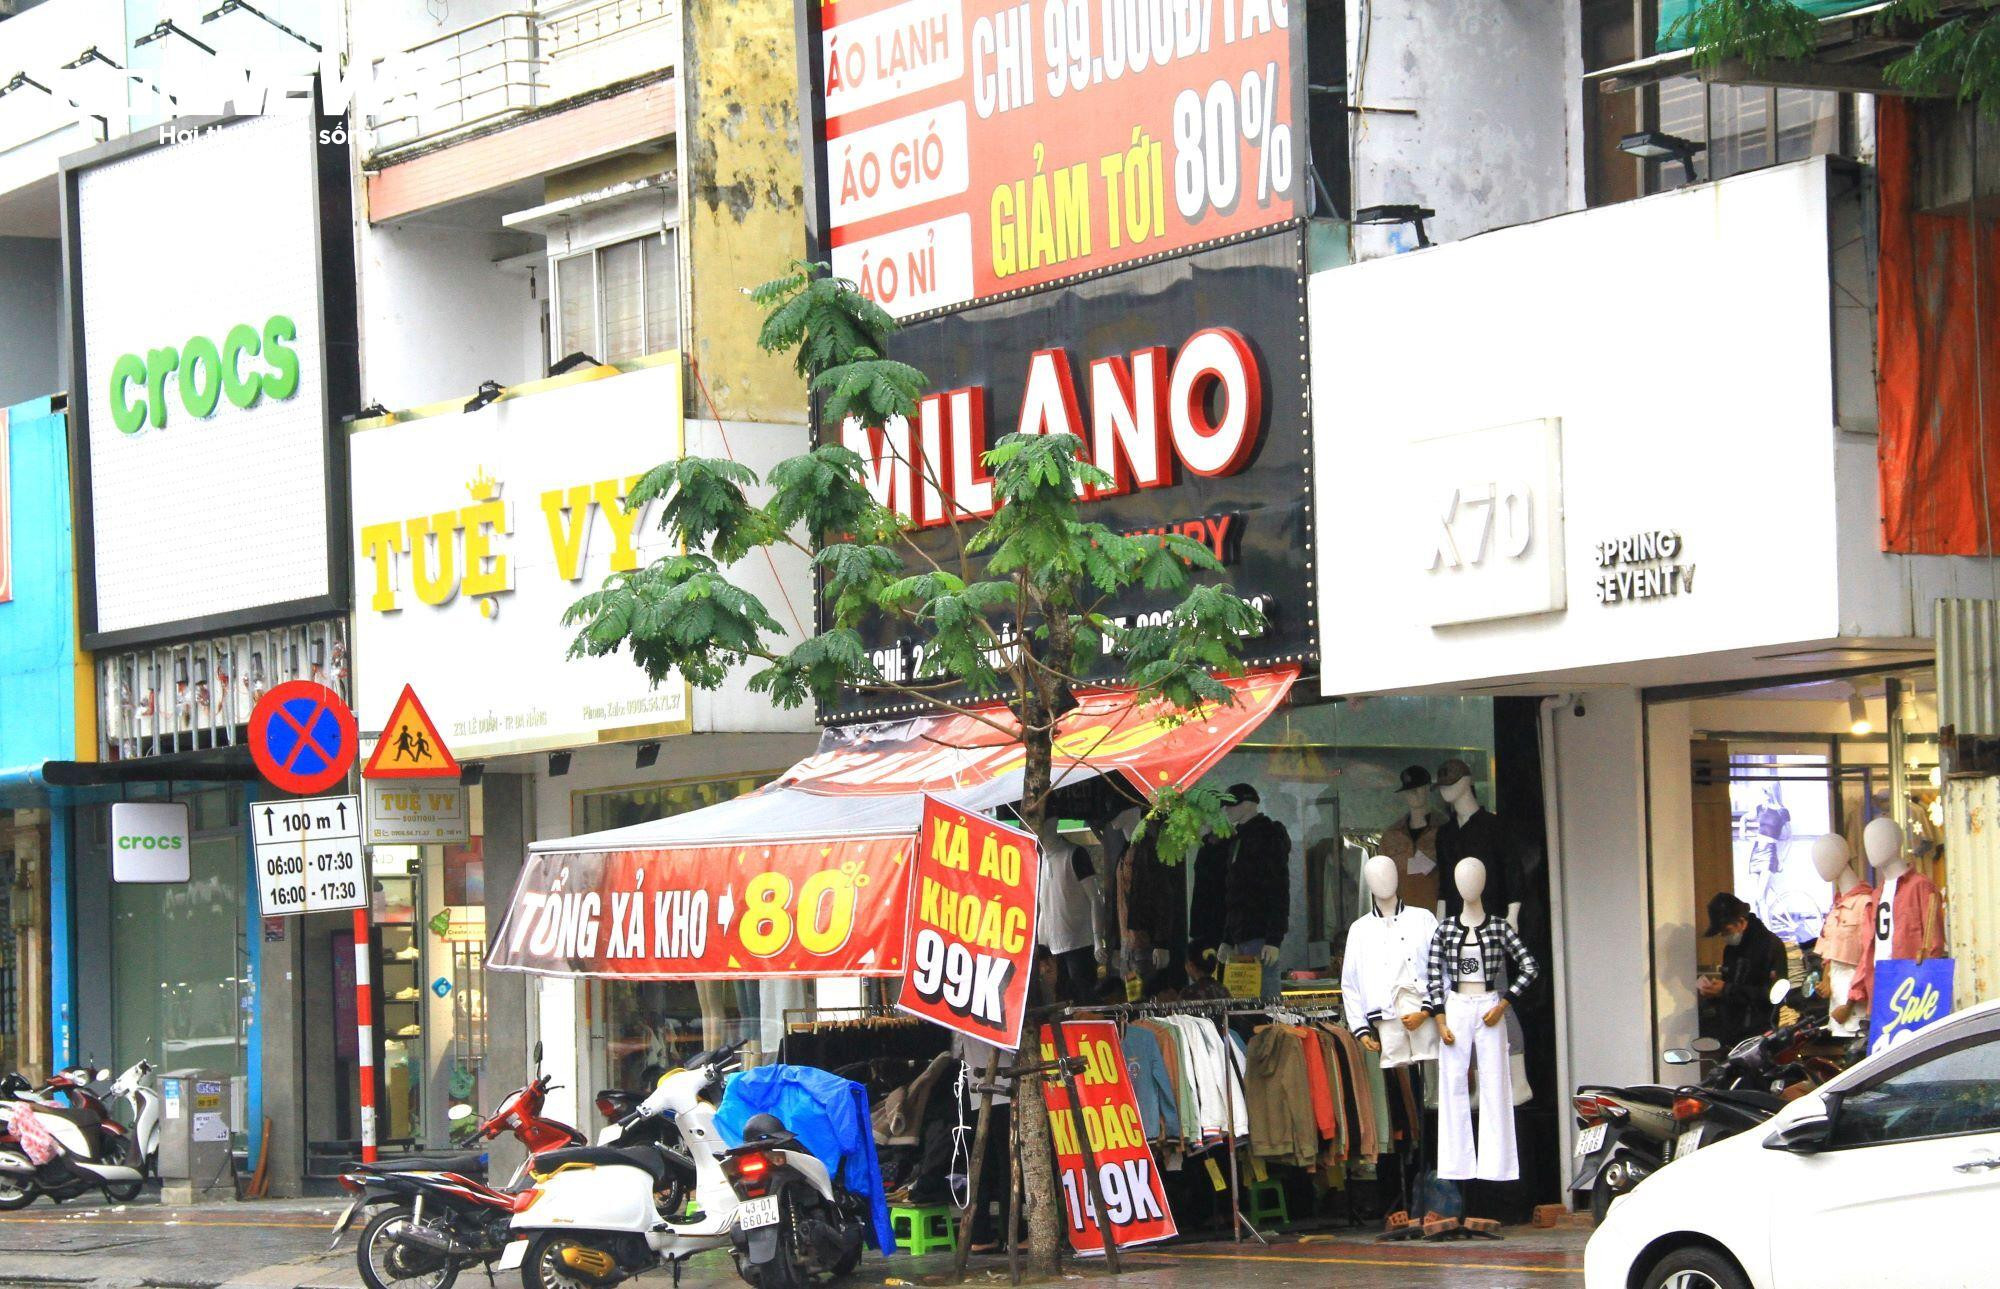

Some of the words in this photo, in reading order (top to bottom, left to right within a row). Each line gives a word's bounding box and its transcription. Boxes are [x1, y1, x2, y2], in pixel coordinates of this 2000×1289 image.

[826, 35, 865, 97] ÁO
[875, 13, 949, 89] LẠNH
[841, 144, 880, 206] ÁO
[890, 119, 944, 190] GIÓ
[990, 141, 1092, 279] GIẢM
[1101, 125, 1165, 249] TỚI
[1173, 62, 1292, 218] 80%
[860, 249, 898, 303] ÁO
[908, 228, 936, 297] NỈ
[110, 315, 299, 434] crocs
[841, 326, 1262, 529] MILANO
[541, 473, 655, 582] VY
[1594, 528, 1682, 567] SPRING
[1595, 562, 1697, 605] SEVENTY
[118, 835, 183, 851] crocs
[283, 813, 311, 833] 100
[317, 815, 331, 830] m
[931, 815, 970, 872] XẢ
[978, 831, 1022, 887] ÁO
[267, 855, 303, 876] 06:00
[318, 852, 353, 872] 07:30
[270, 885, 307, 906] 16:00
[320, 881, 356, 901] 17:30
[509, 867, 601, 960] TỔNG
[606, 867, 645, 960] XẢ
[653, 889, 709, 960] KHO
[920, 875, 1027, 954] KHOÁC
[1875, 901, 1891, 941] G
[912, 928, 1013, 1026] 99K
[1882, 976, 1940, 1034] Sale
[1077, 1033, 1119, 1085] ÁO
